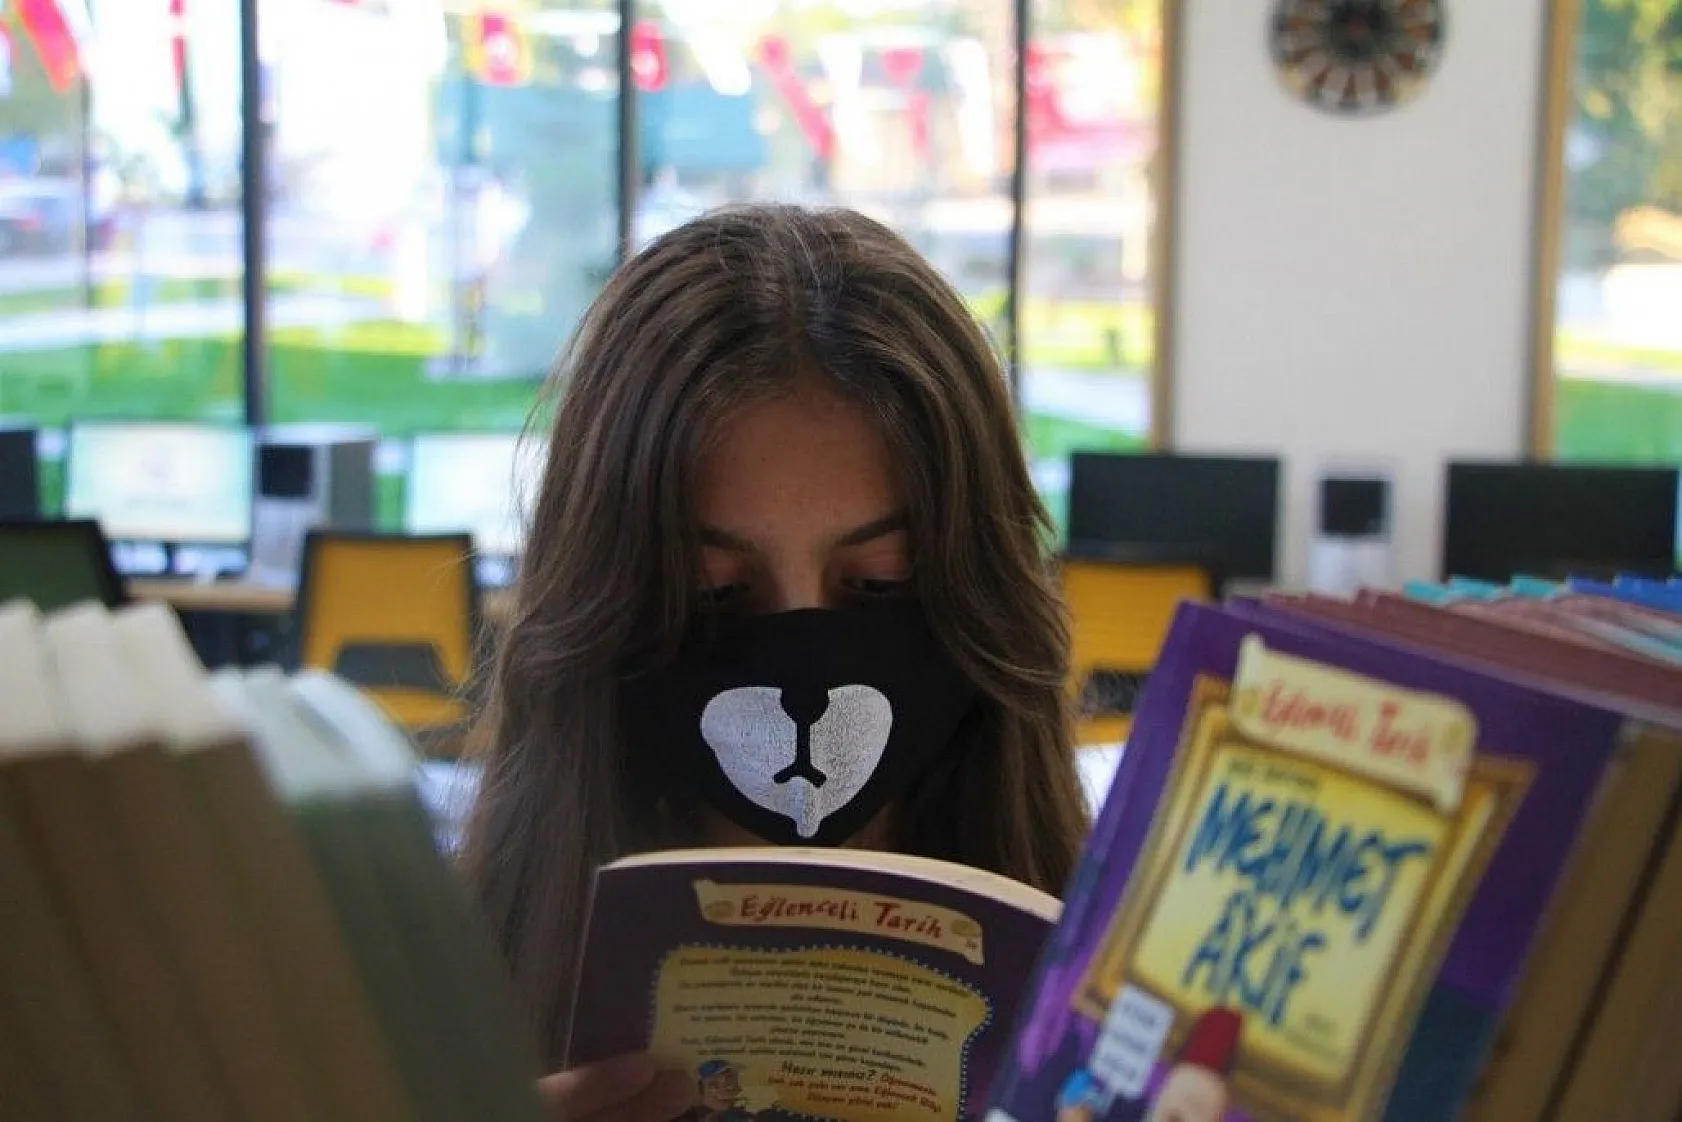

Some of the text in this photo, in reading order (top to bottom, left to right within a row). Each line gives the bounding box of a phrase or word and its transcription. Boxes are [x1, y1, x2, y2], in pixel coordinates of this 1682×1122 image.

[1185, 783, 1430, 943] MEHMET
[740, 894, 943, 938] Eğlenceli Tarih
